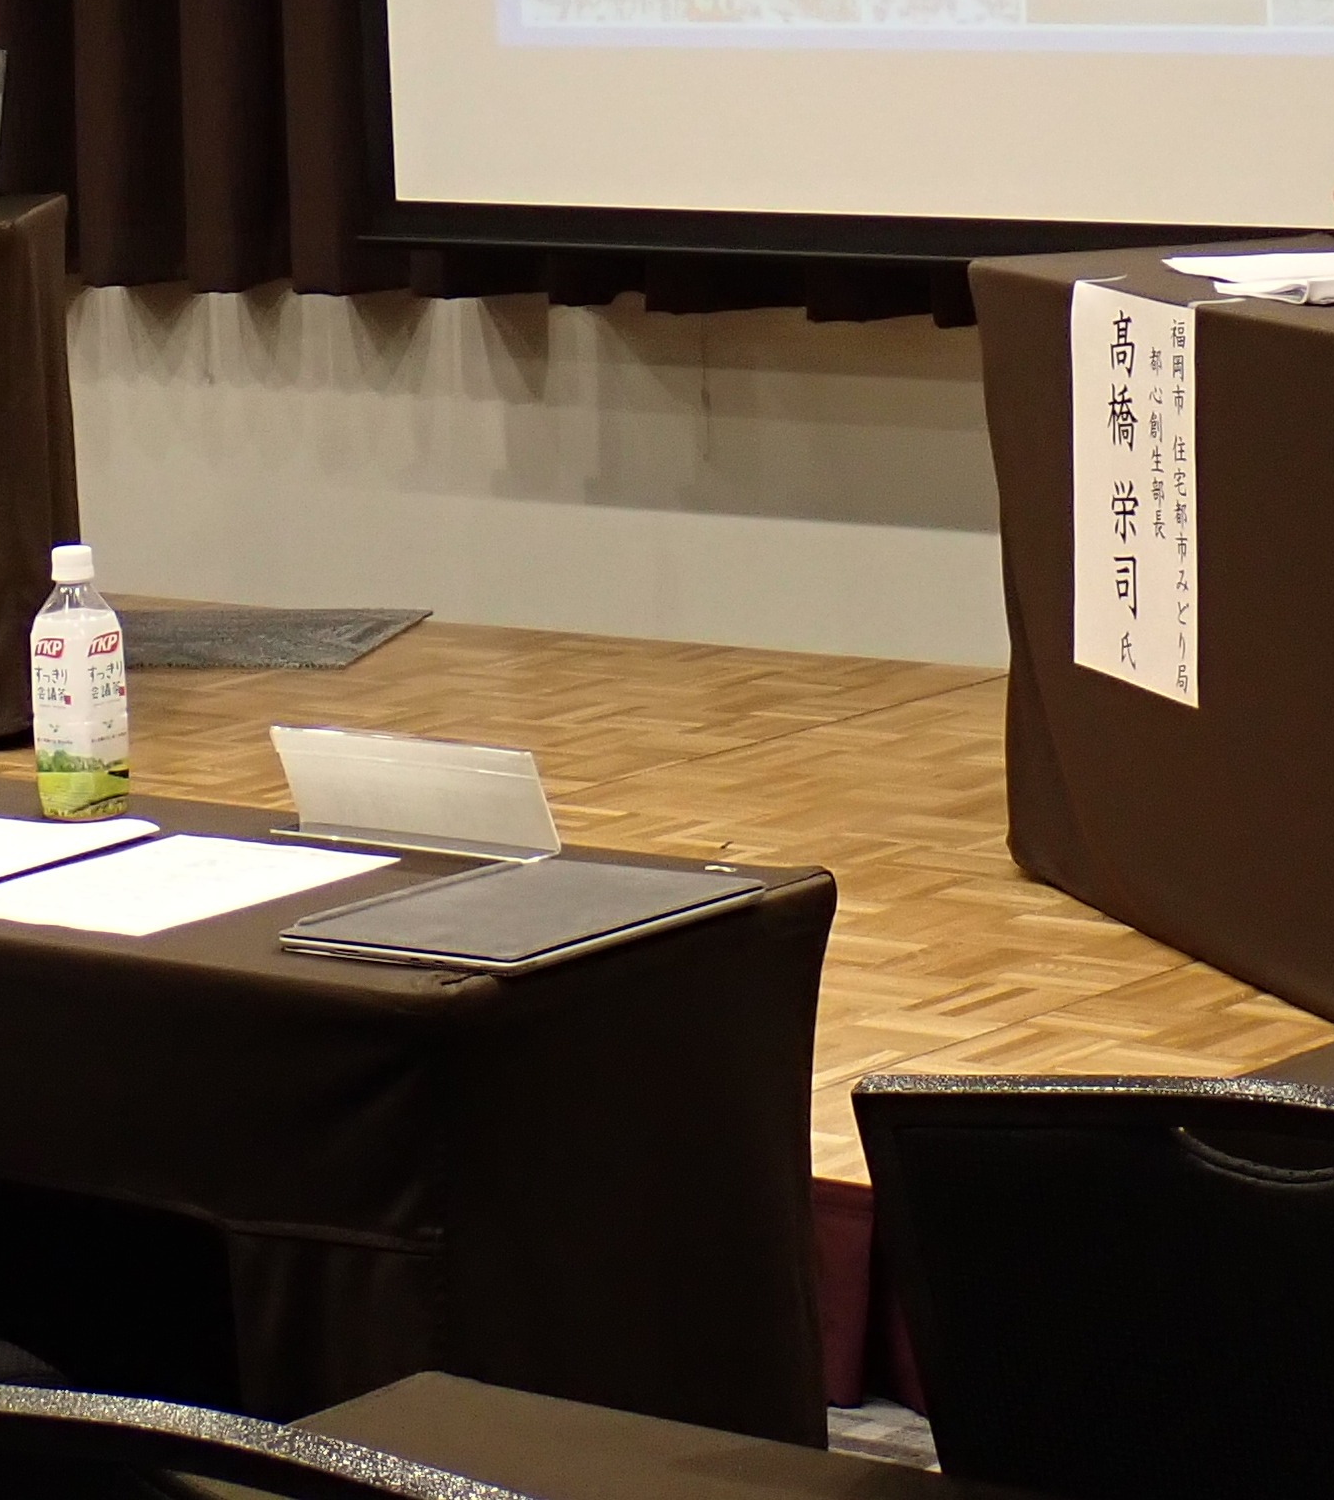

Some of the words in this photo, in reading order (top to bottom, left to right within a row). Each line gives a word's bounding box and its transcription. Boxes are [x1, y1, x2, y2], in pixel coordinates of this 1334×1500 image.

[1148, 347, 1166, 540] 都心創生部長
[35, 639, 63, 656] TKP
[90, 633, 118, 654] TKP
[34, 665, 68, 685] すっきり
[88, 660, 123, 683] すっきり
